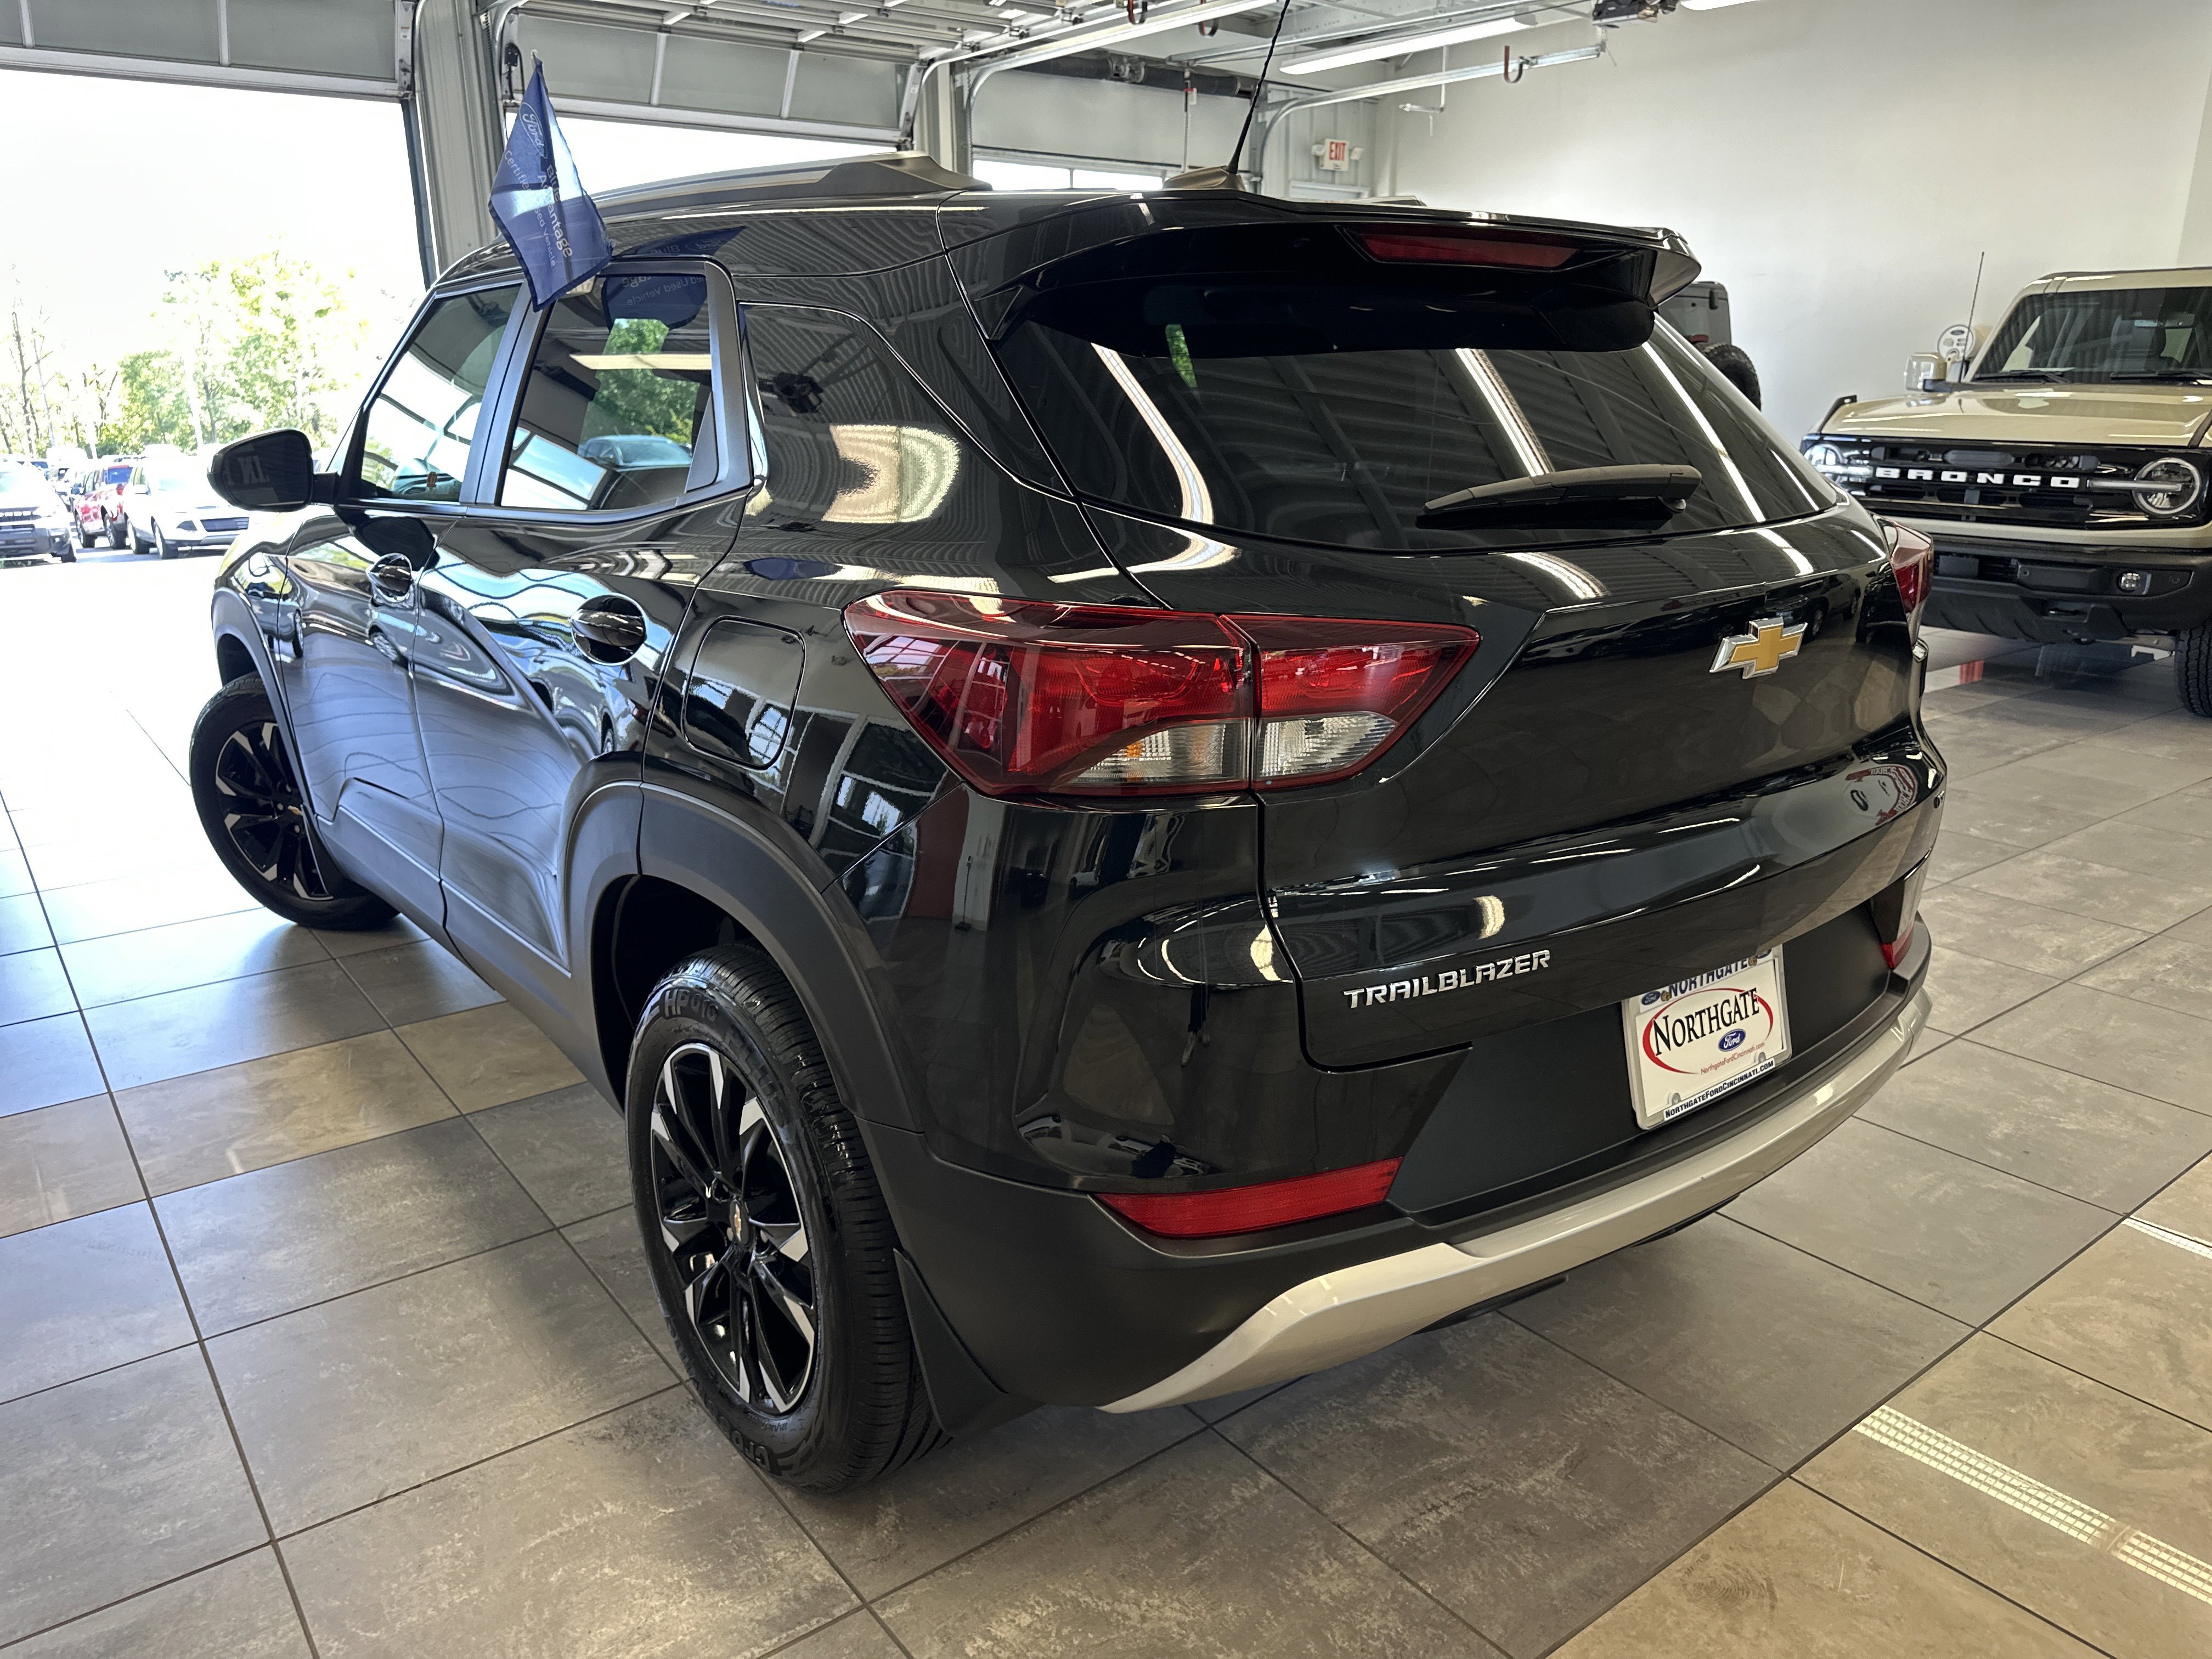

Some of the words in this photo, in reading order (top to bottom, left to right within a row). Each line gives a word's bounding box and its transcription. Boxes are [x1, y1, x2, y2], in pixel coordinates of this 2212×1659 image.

[522, 113, 545, 149] Ford
[1329, 141, 1347, 161] EXIT
[504, 149, 531, 192] Certifie
[538, 174, 573, 258] Aantage
[1875, 467, 2080, 488] BRONCO
[1343, 950, 1551, 1008] TRAILBLAZER
[1653, 988, 1760, 1056] NORTHGATE
